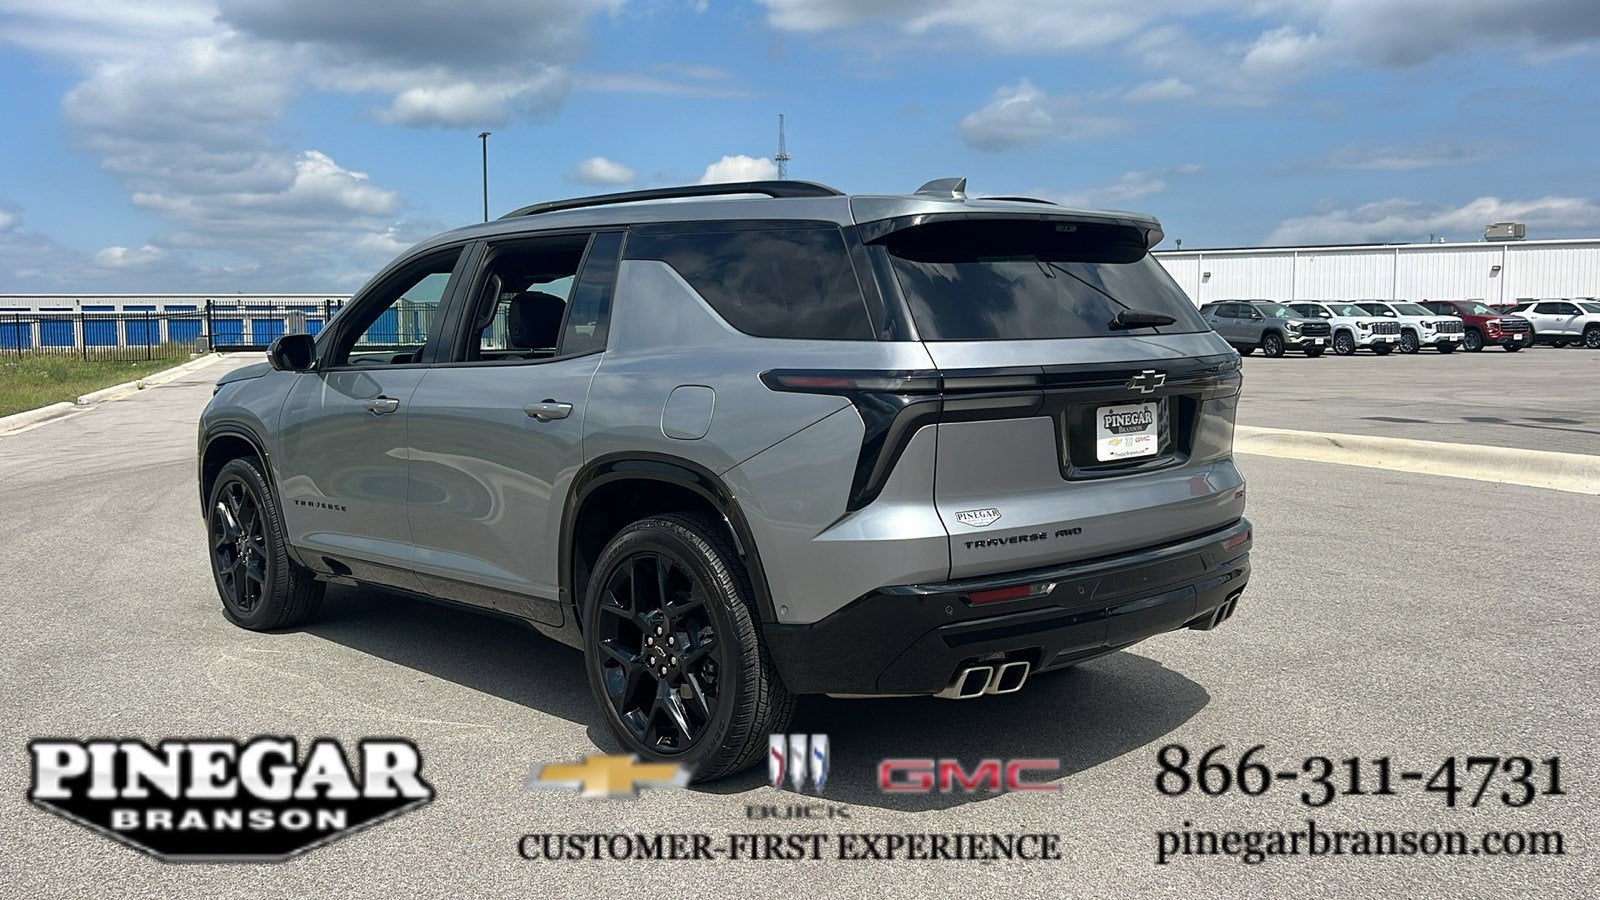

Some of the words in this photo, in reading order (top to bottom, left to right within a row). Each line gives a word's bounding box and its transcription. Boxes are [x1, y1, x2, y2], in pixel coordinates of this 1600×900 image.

[1105, 412, 1152, 428] PINEGAR
[1118, 425, 1144, 433] BRANSON
[957, 510, 999, 521] PINEGAR
[964, 532, 1048, 549] TRAVERSE
[1055, 527, 1082, 538] AWD
